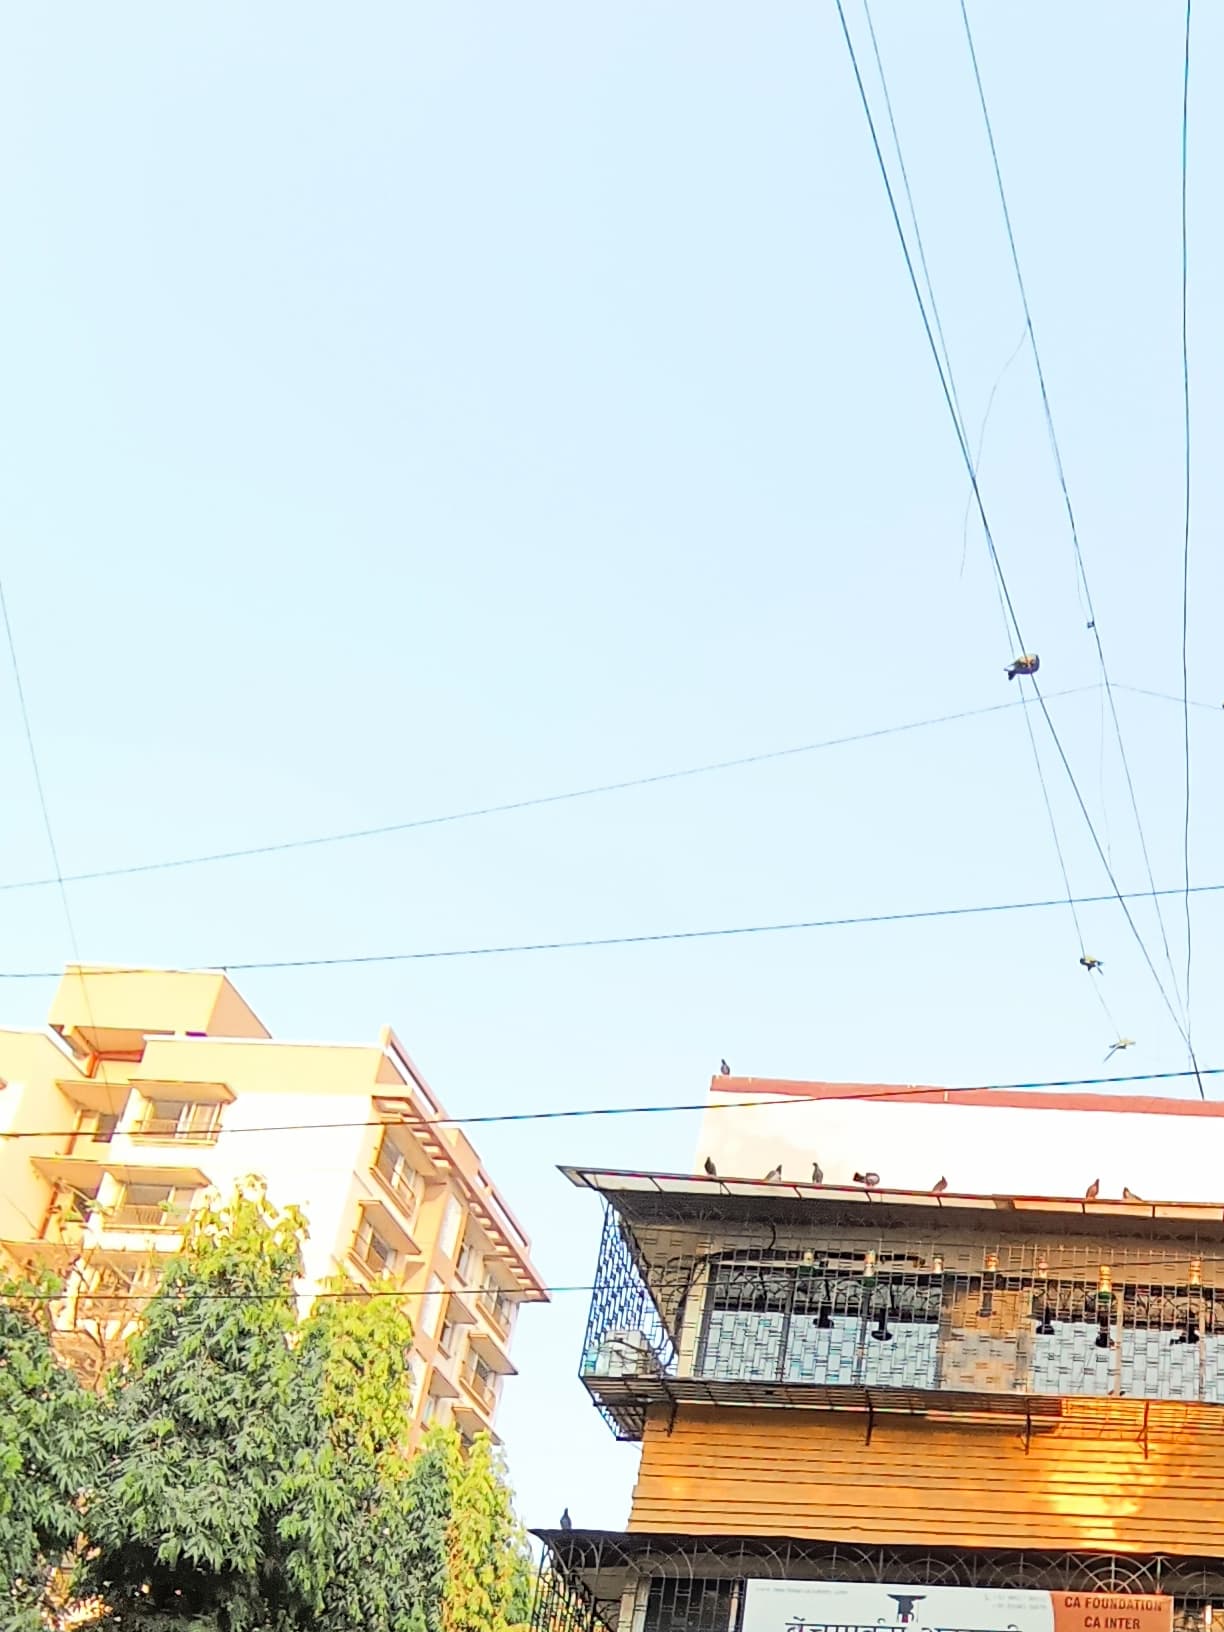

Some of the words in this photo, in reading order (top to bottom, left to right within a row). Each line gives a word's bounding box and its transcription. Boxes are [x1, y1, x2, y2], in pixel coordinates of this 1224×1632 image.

[1064, 1596, 1081, 1609] CA
[1085, 1596, 1163, 1612] FOUNDATION
[1084, 1616, 1101, 1628] CA
[1104, 1616, 1141, 1630] INTER
